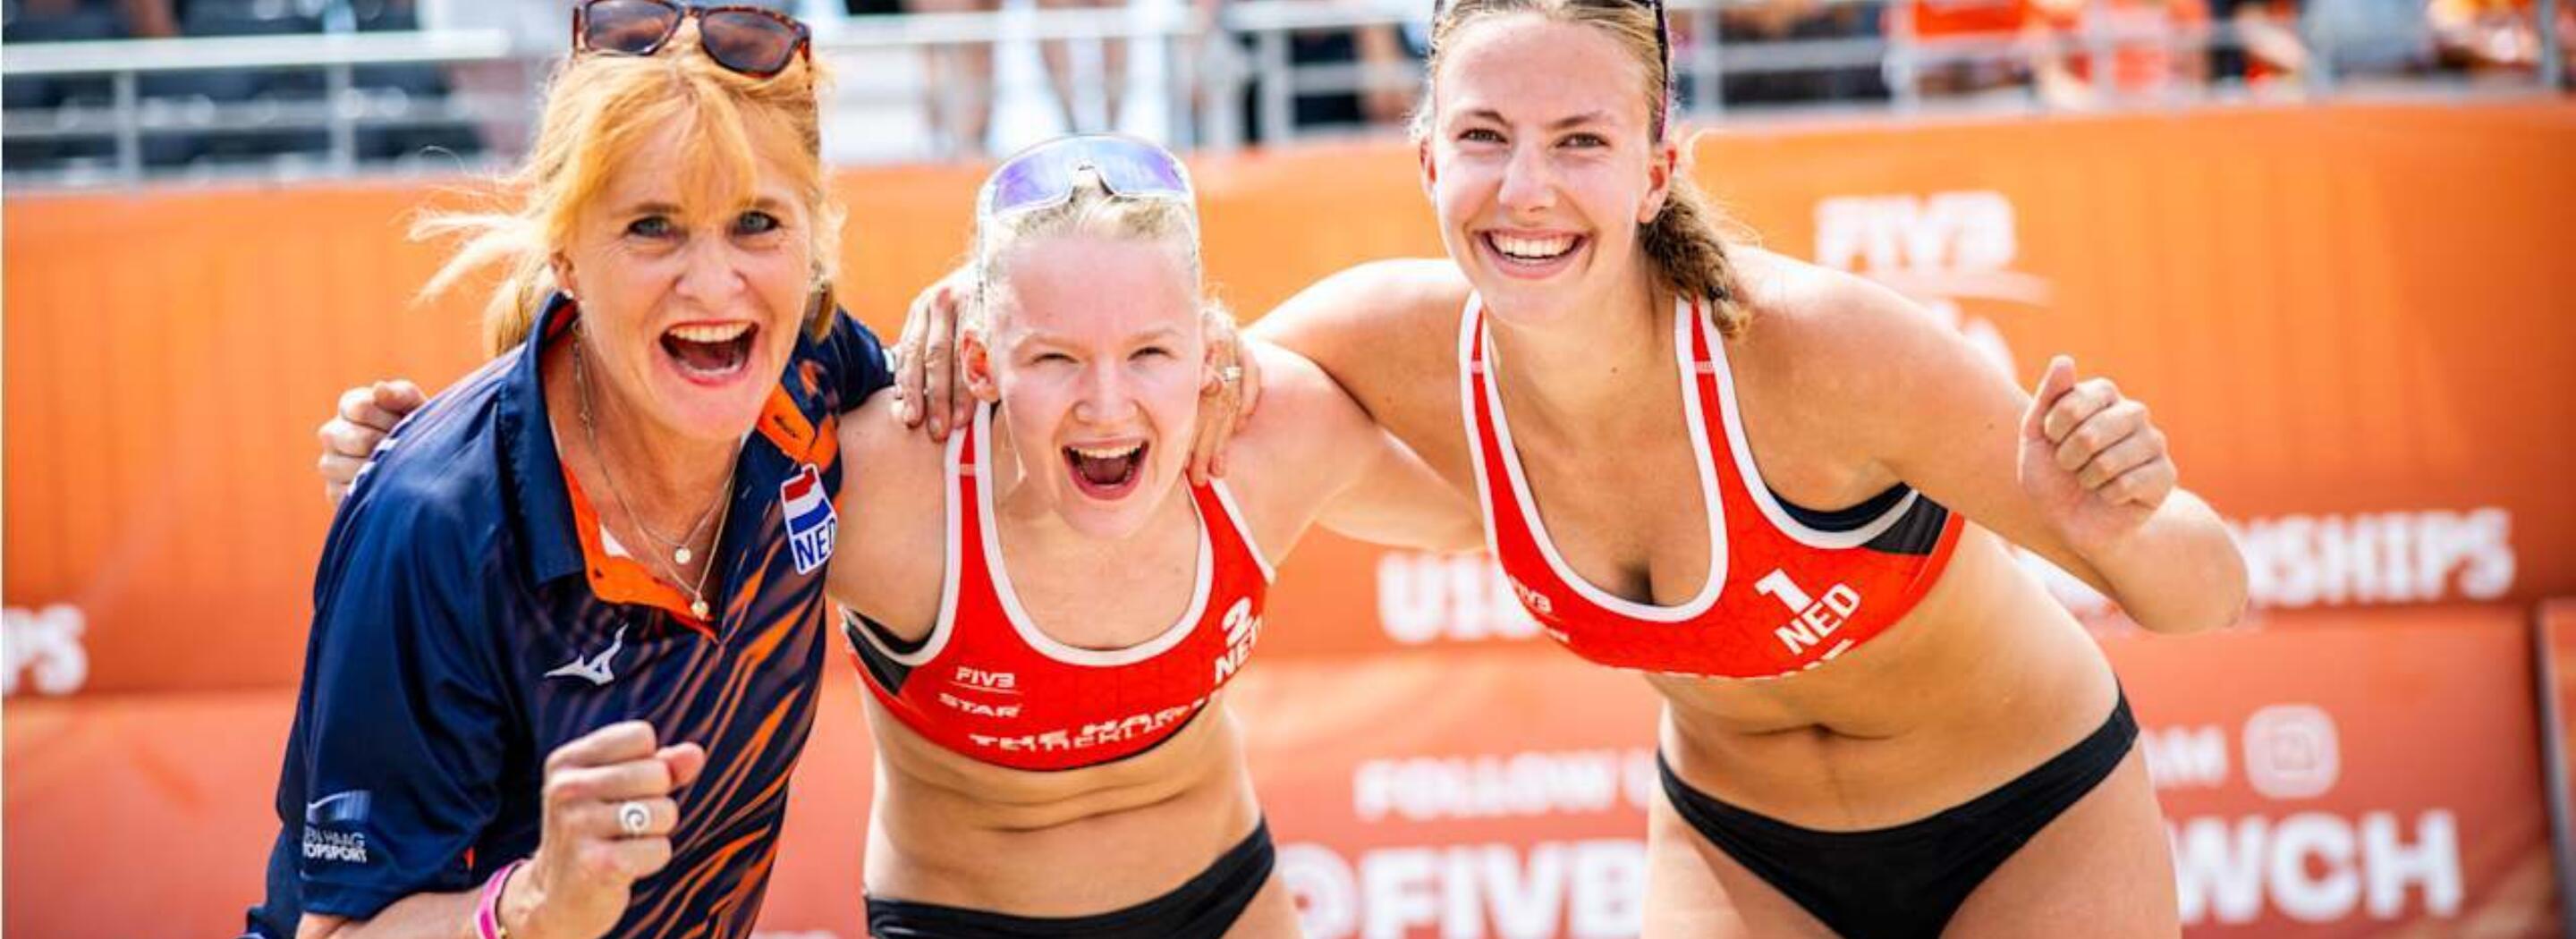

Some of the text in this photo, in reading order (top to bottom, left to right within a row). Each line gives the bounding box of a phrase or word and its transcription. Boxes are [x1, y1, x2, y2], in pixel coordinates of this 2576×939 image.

[1754, 568, 1812, 613] 1
[1222, 596, 1251, 647] 2
[1775, 582, 1860, 655] NED
